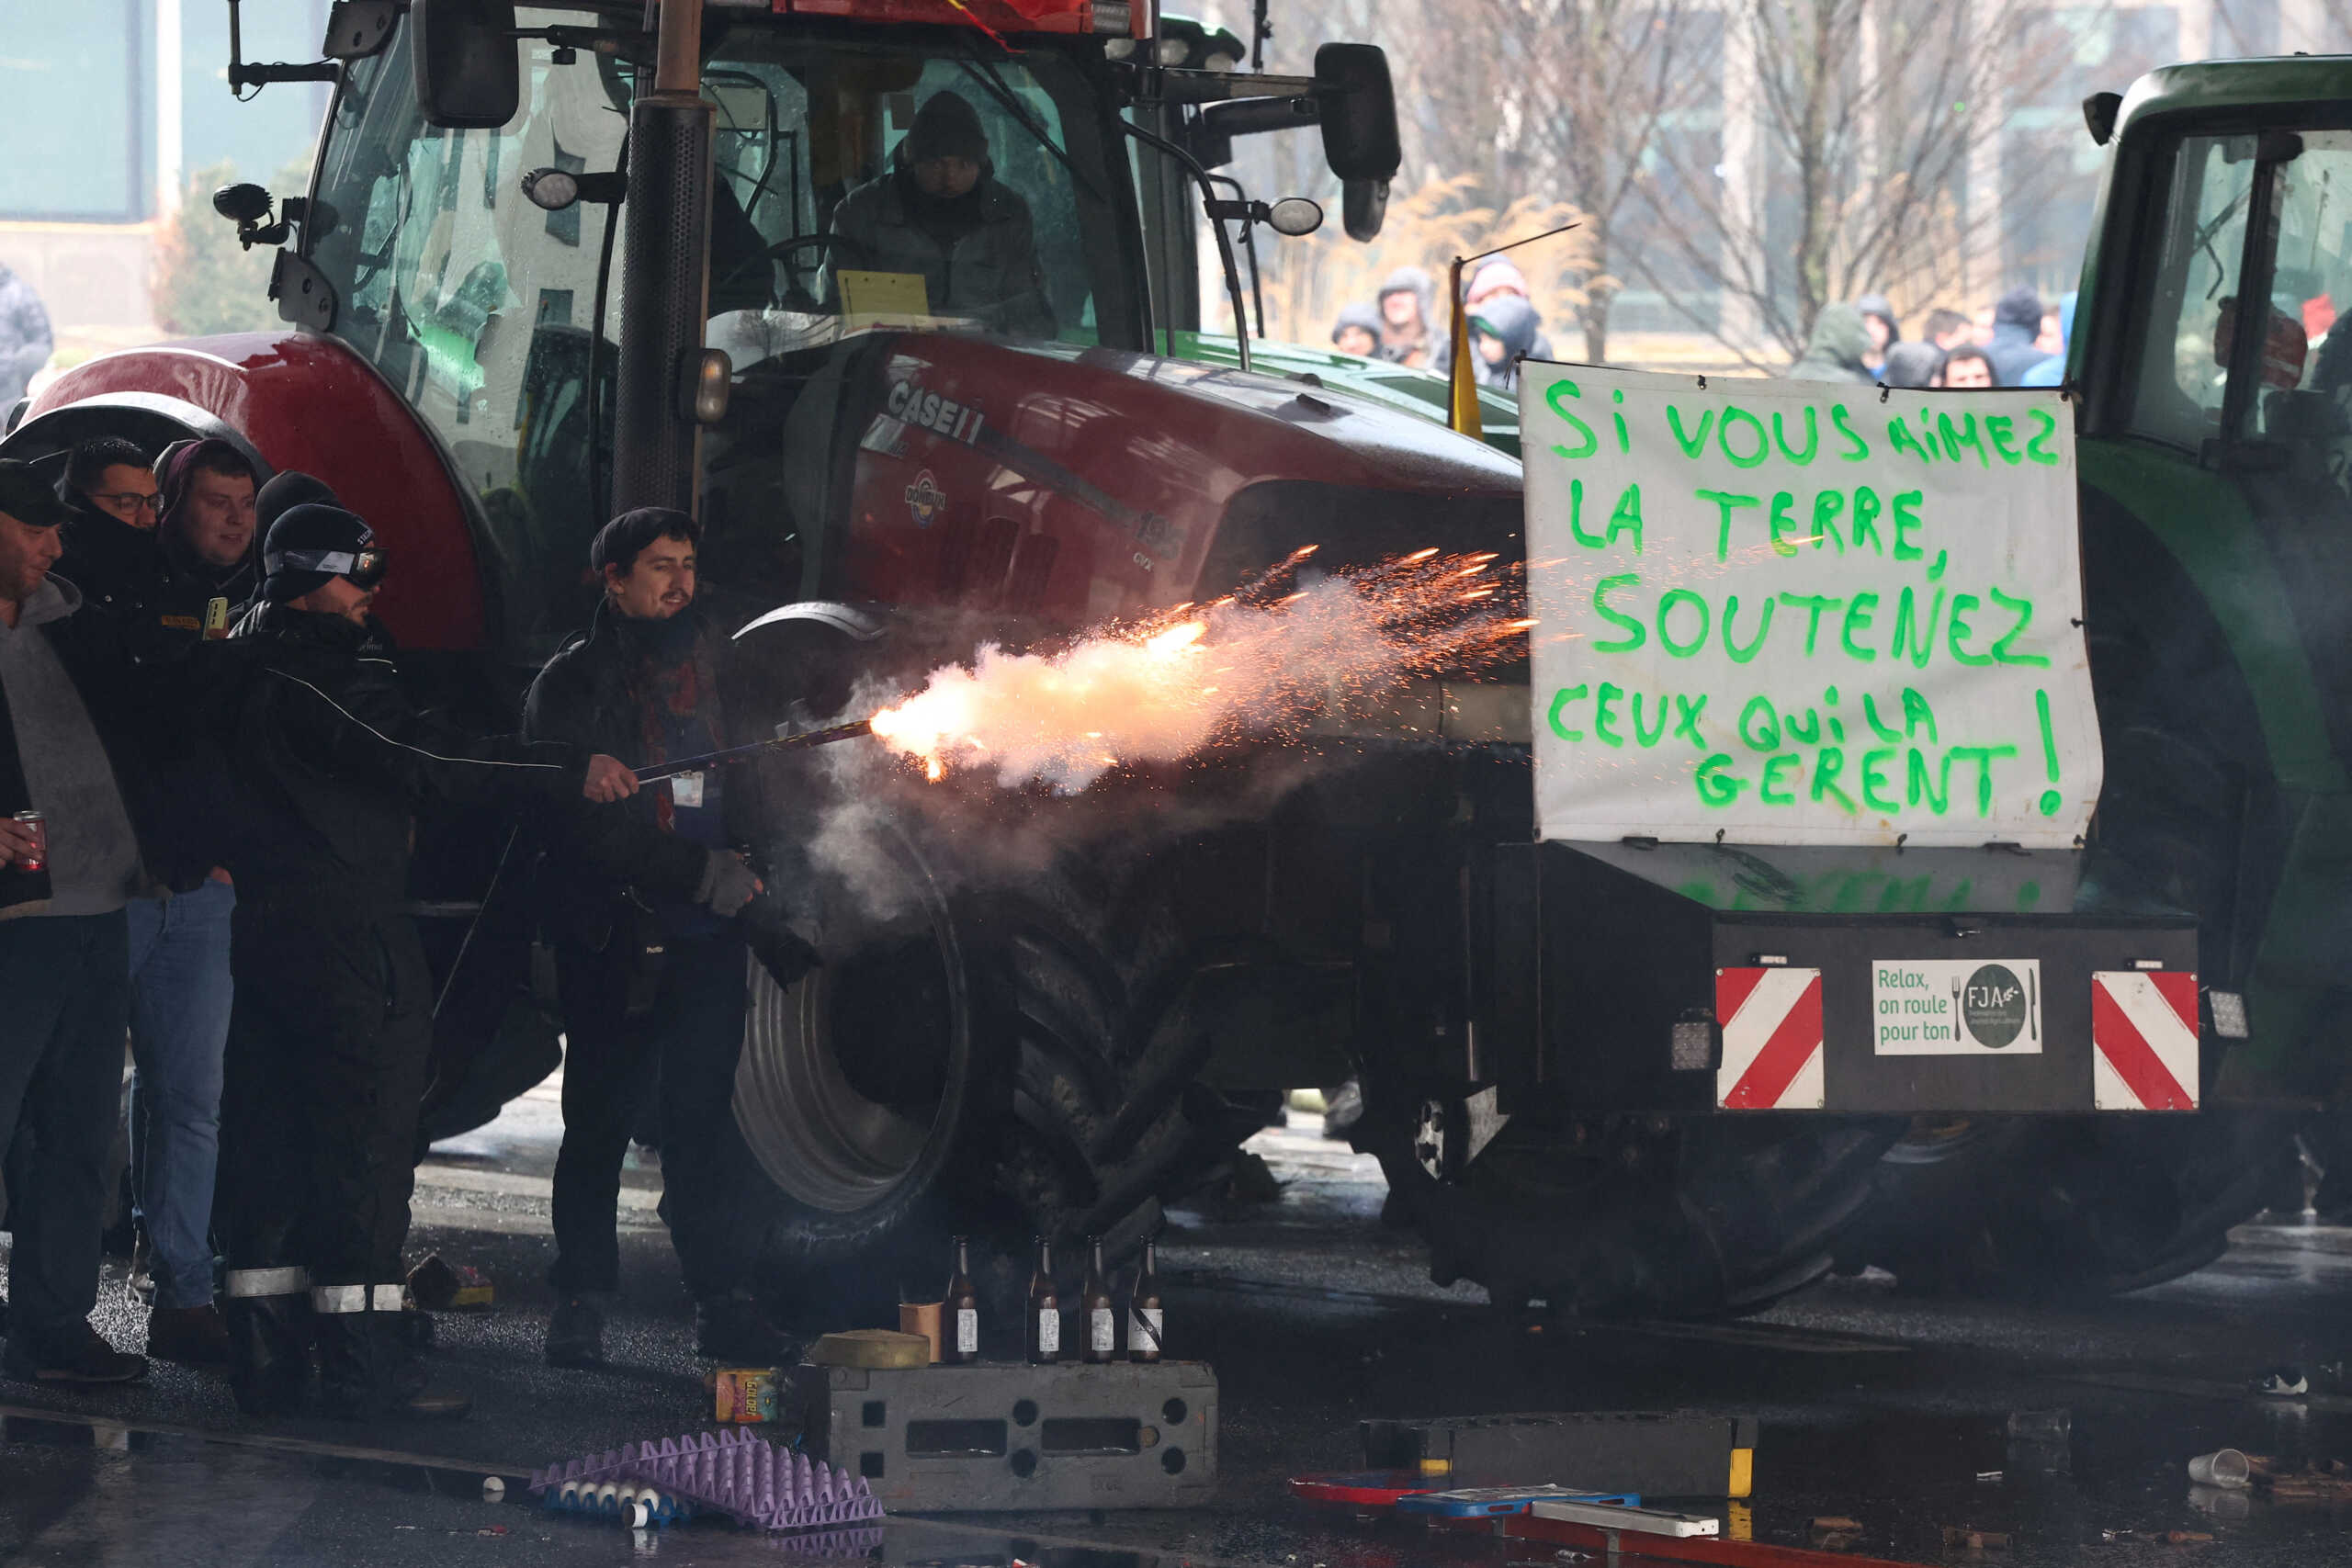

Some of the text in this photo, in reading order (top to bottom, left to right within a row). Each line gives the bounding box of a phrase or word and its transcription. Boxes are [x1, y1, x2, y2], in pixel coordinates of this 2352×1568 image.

[889, 380, 959, 434] CASE
[1544, 378, 1631, 459] Si
[1666, 403, 1871, 469] VOUS
[1570, 479, 1949, 583] LA TERRE,
[1592, 572, 2052, 670] SOUTENEZ
[1547, 681, 1709, 751] CEUX
[1862, 686, 1939, 747] LA
[1693, 743, 2018, 818] GERENT
[1878, 968, 1929, 991] Relax,
[1879, 994, 1948, 1014] on roule
[1968, 986, 2004, 1008] FJA
[1880, 1021, 1951, 1046] pour ton
